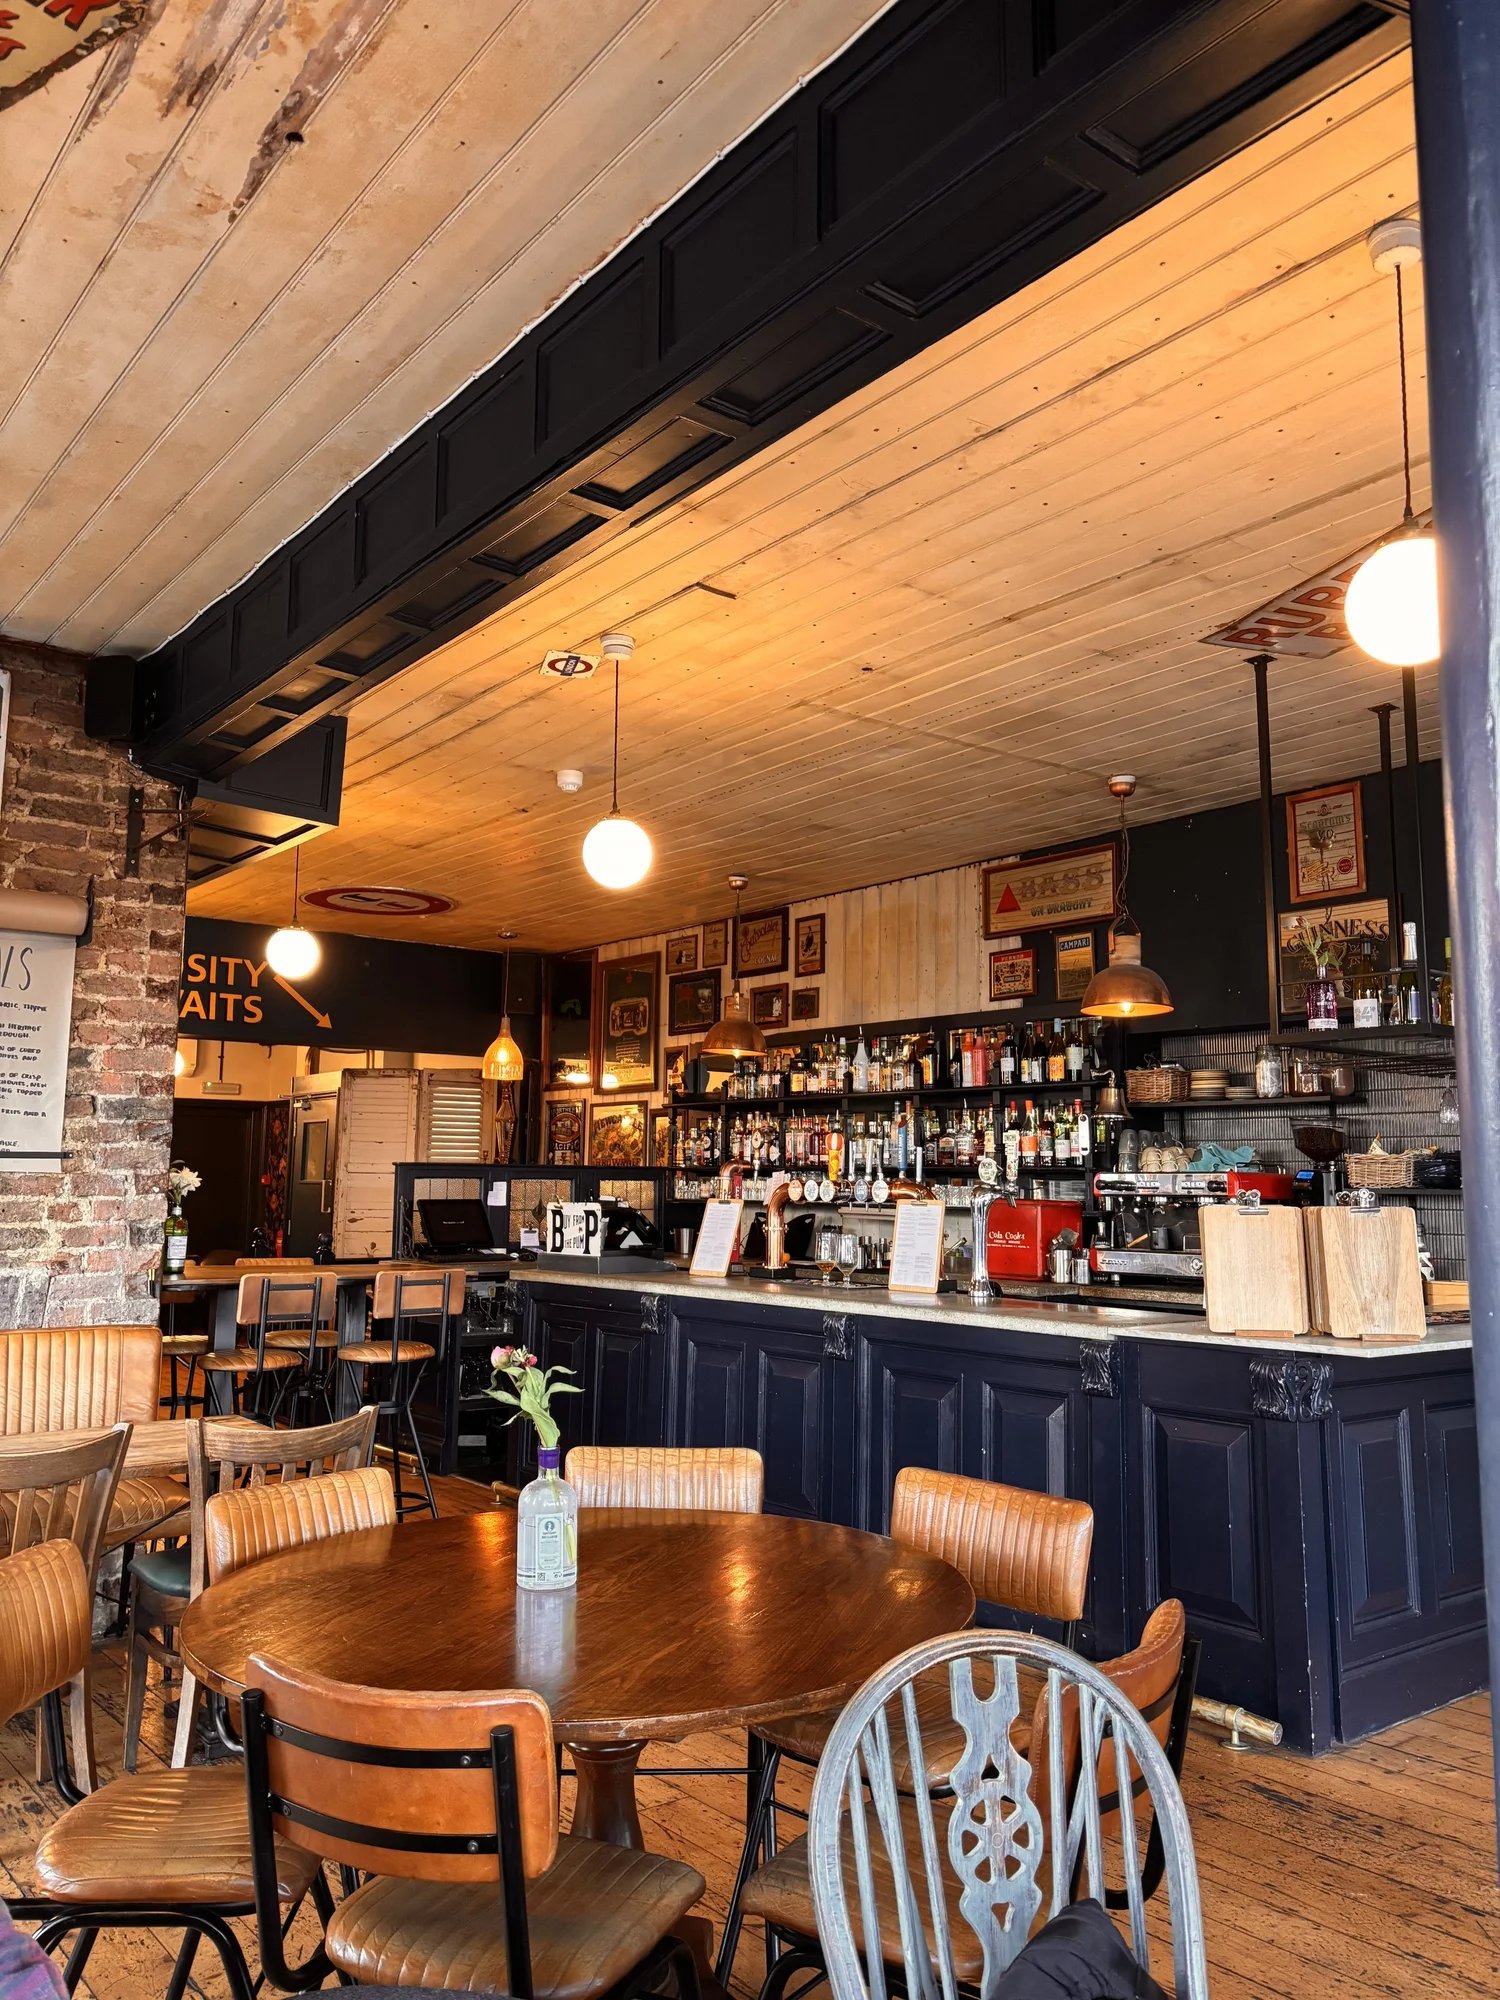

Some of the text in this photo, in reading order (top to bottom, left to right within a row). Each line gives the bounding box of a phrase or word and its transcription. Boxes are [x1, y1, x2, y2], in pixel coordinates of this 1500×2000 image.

[1060, 938, 1089, 951] CAMPARI
[1286, 918, 1389, 954] GUINNESS
[0, 945, 33, 991] LS
[187, 953, 269, 987] SITY
[179, 988, 263, 1024] AITS
